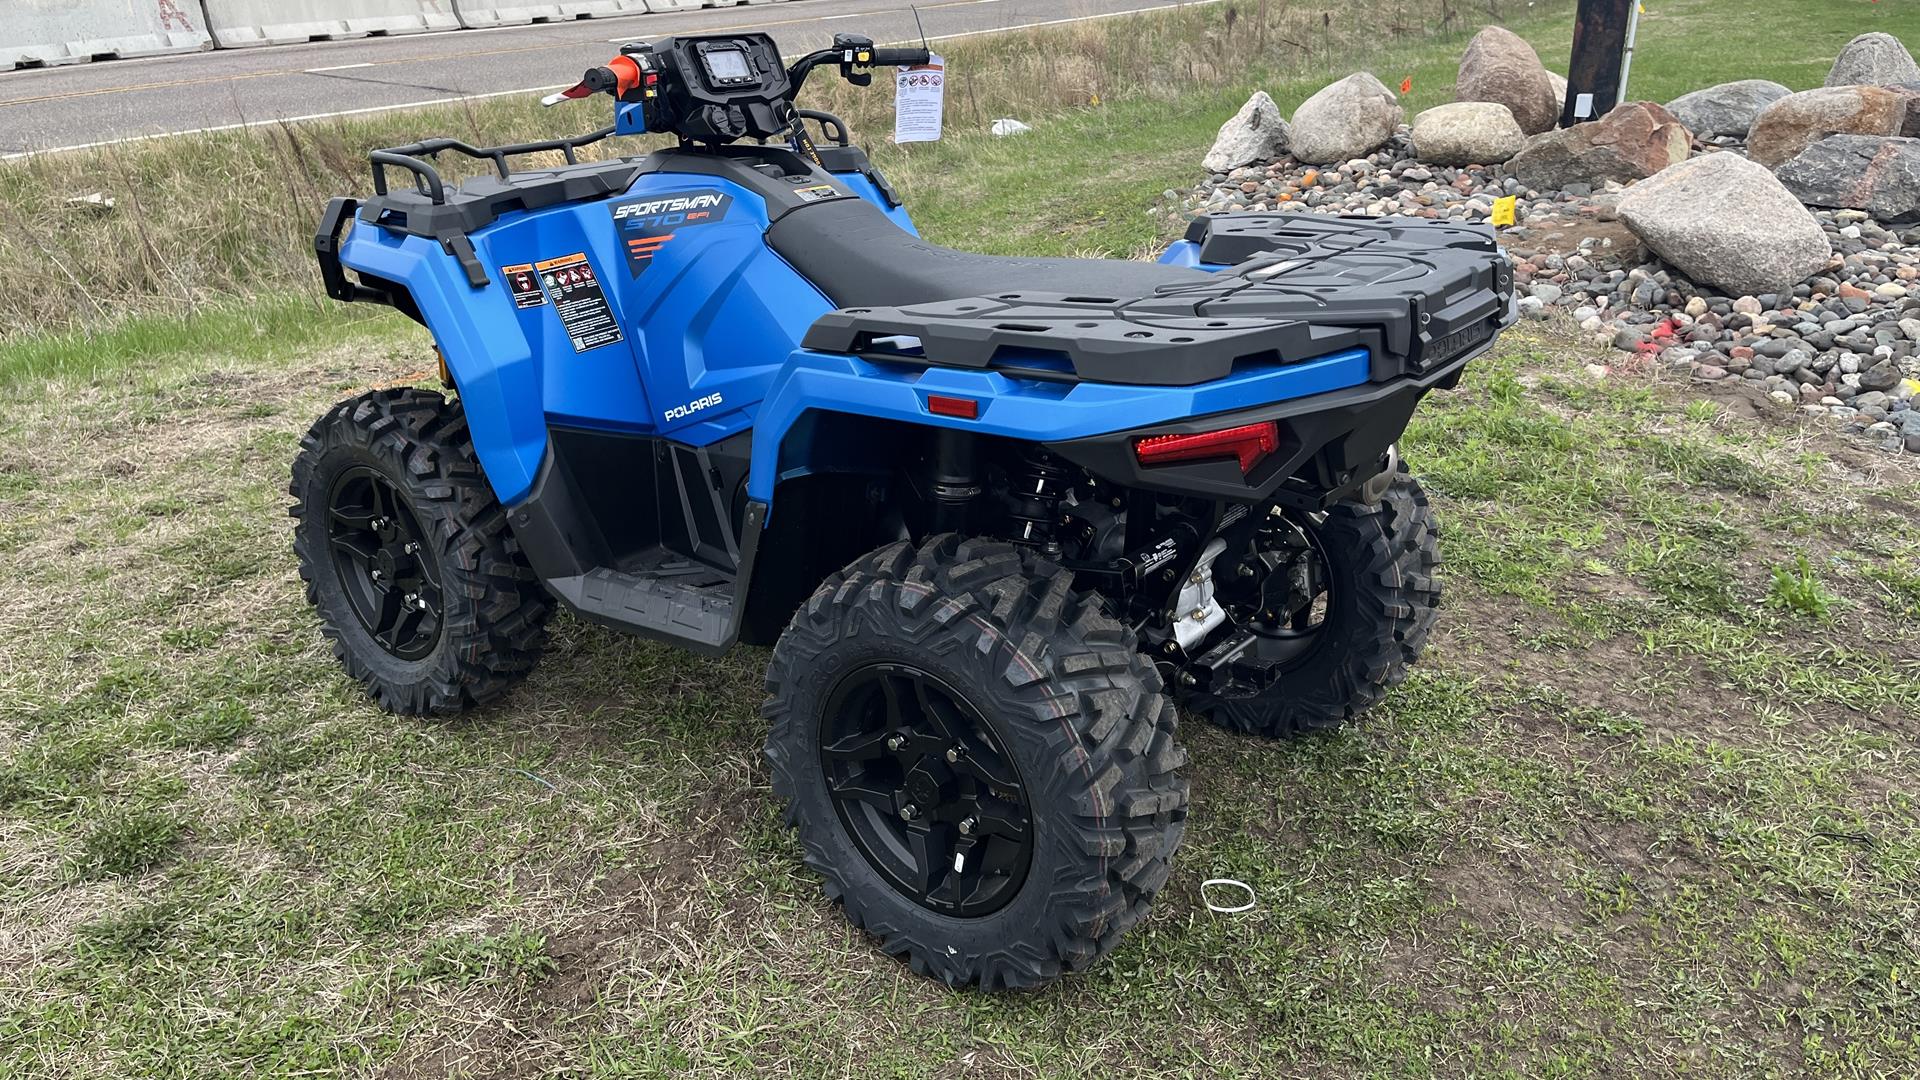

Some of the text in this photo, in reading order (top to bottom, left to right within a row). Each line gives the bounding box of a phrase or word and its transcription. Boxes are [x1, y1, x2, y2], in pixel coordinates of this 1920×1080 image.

[613, 193, 724, 220] SPORTSMAN
[624, 211, 710, 231] 570 EFI
[664, 391, 723, 422] POLARIS
